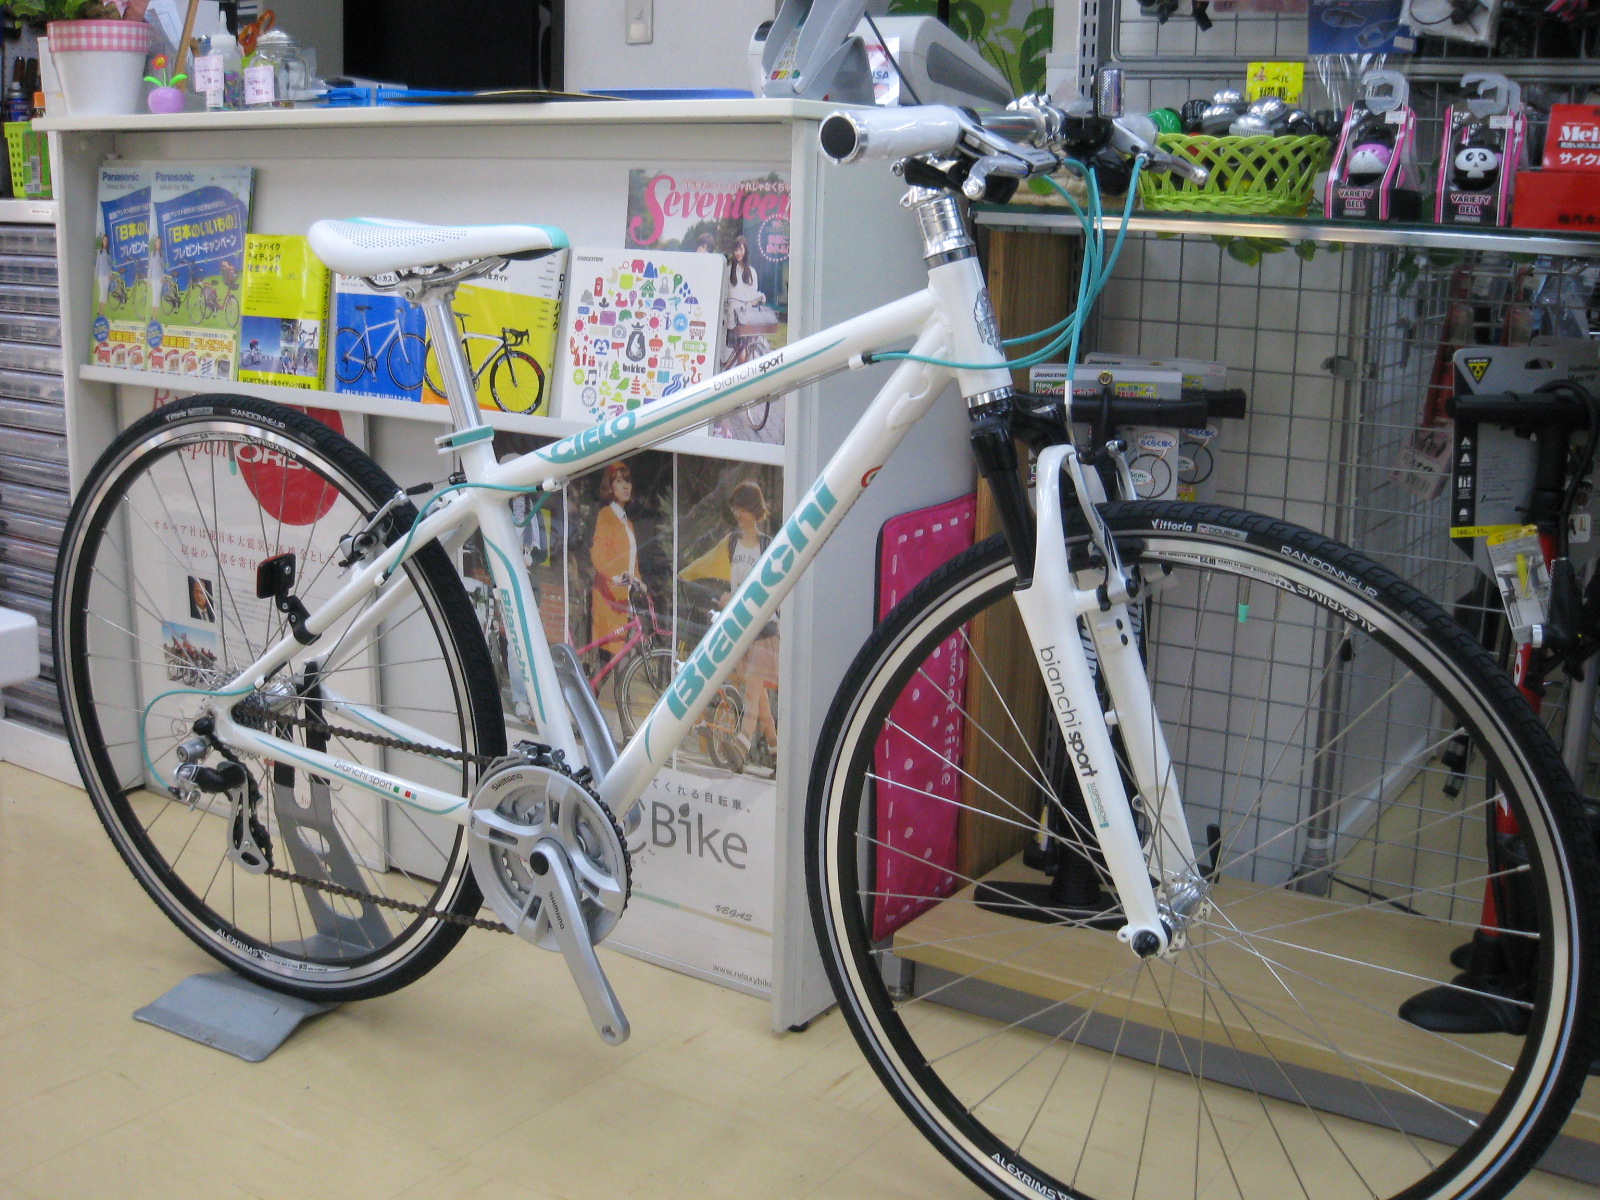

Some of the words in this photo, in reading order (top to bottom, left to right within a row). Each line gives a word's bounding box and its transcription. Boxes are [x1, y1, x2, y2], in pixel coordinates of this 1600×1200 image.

[1559, 152, 1600, 166] サイク
[102, 171, 139, 182] Panasonic
[155, 171, 194, 182] Panasonic
[1338, 188, 1373, 199] VARIETY
[1345, 199, 1365, 209] BELL
[1451, 194, 1491, 205] VARIETY
[1459, 205, 1481, 215] BELL
[168, 213, 238, 246] 「日本のいいもの」
[174, 234, 236, 261] プレゼントキャンペーン
[713, 362, 759, 391] bianchi
[759, 352, 785, 375] sport
[231, 408, 286, 430] RANDONNEUR
[251, 436, 297, 459] ALEXRIMS
[550, 410, 636, 463] CIELO
[1151, 518, 1193, 532] Vittoria
[1281, 545, 1378, 598] RANDONNEUR
[666, 475, 838, 720] Bianchi
[1297, 583, 1377, 633] ALEXRIMS
[1040, 646, 1082, 728] bianchi
[1069, 730, 1098, 777] sport
[334, 759, 369, 780] bianchi
[370, 775, 393, 790] sport
[491, 773, 523, 791] SHIMANO
[549, 891, 565, 930] SHIMANO
[715, 904, 753, 922] VEGAS
[216, 928, 259, 957] ALEXRIMS
[991, 1152, 1057, 1200] ALEXRIMS
